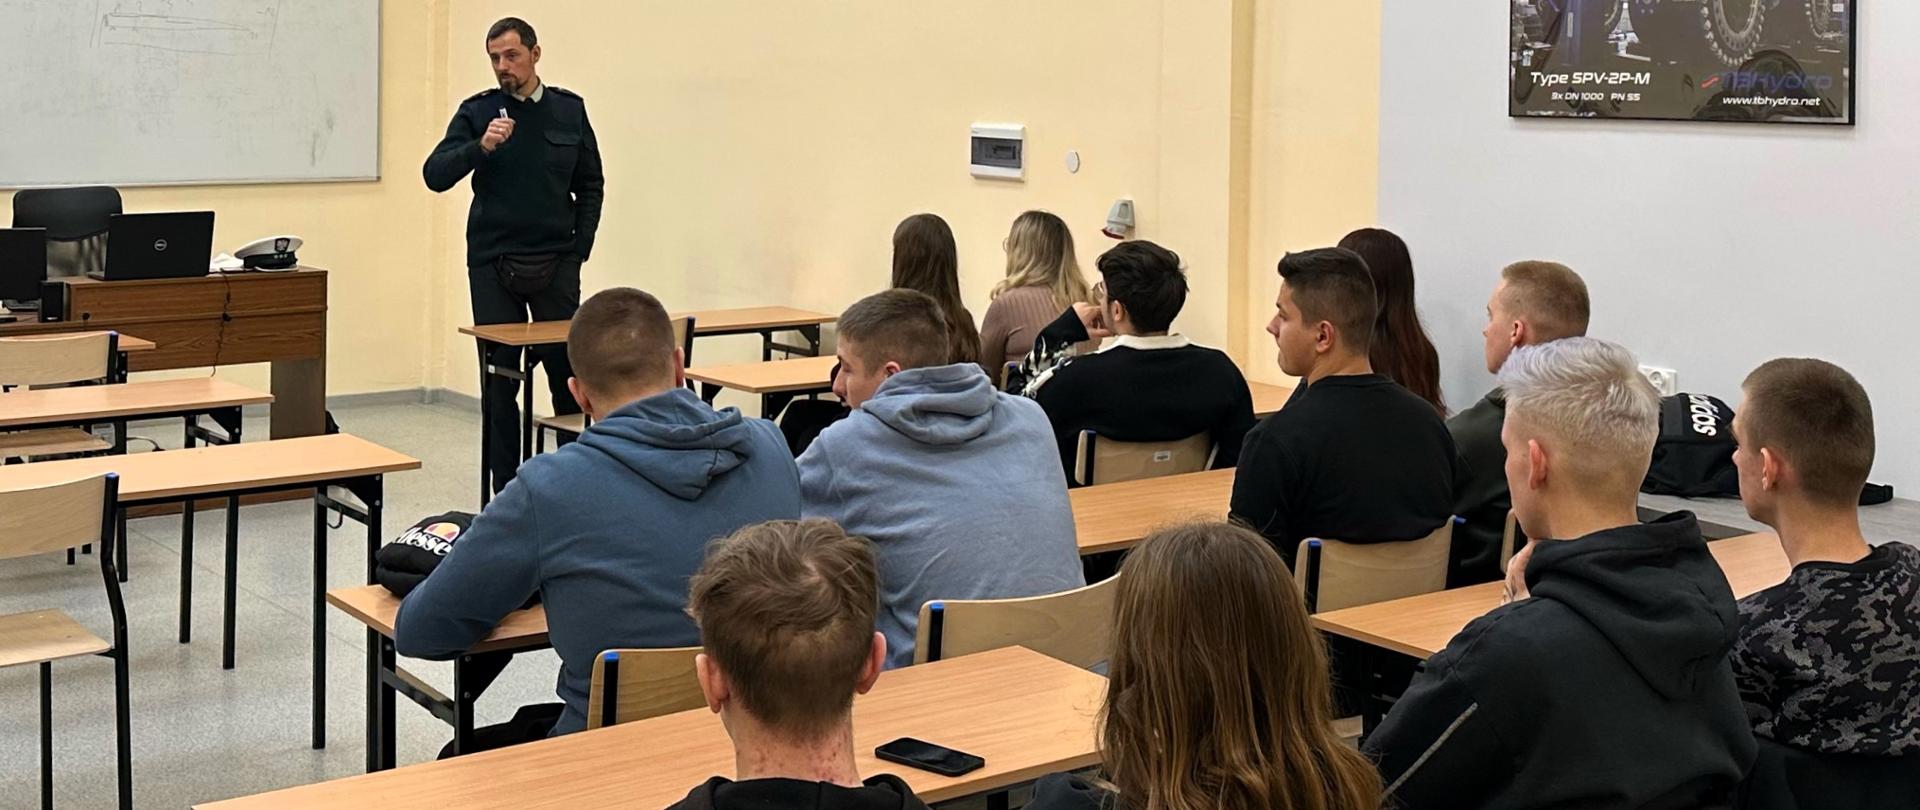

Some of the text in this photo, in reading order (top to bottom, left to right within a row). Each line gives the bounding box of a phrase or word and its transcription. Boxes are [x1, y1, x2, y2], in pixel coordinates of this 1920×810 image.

[1531, 72, 1651, 87] Type SPV-2P-M
[1565, 92, 1580, 101] DN
[1581, 92, 1604, 101] 1000
[1610, 93, 1625, 101] PN
[1722, 96, 1821, 108] www.tbhydro.net
